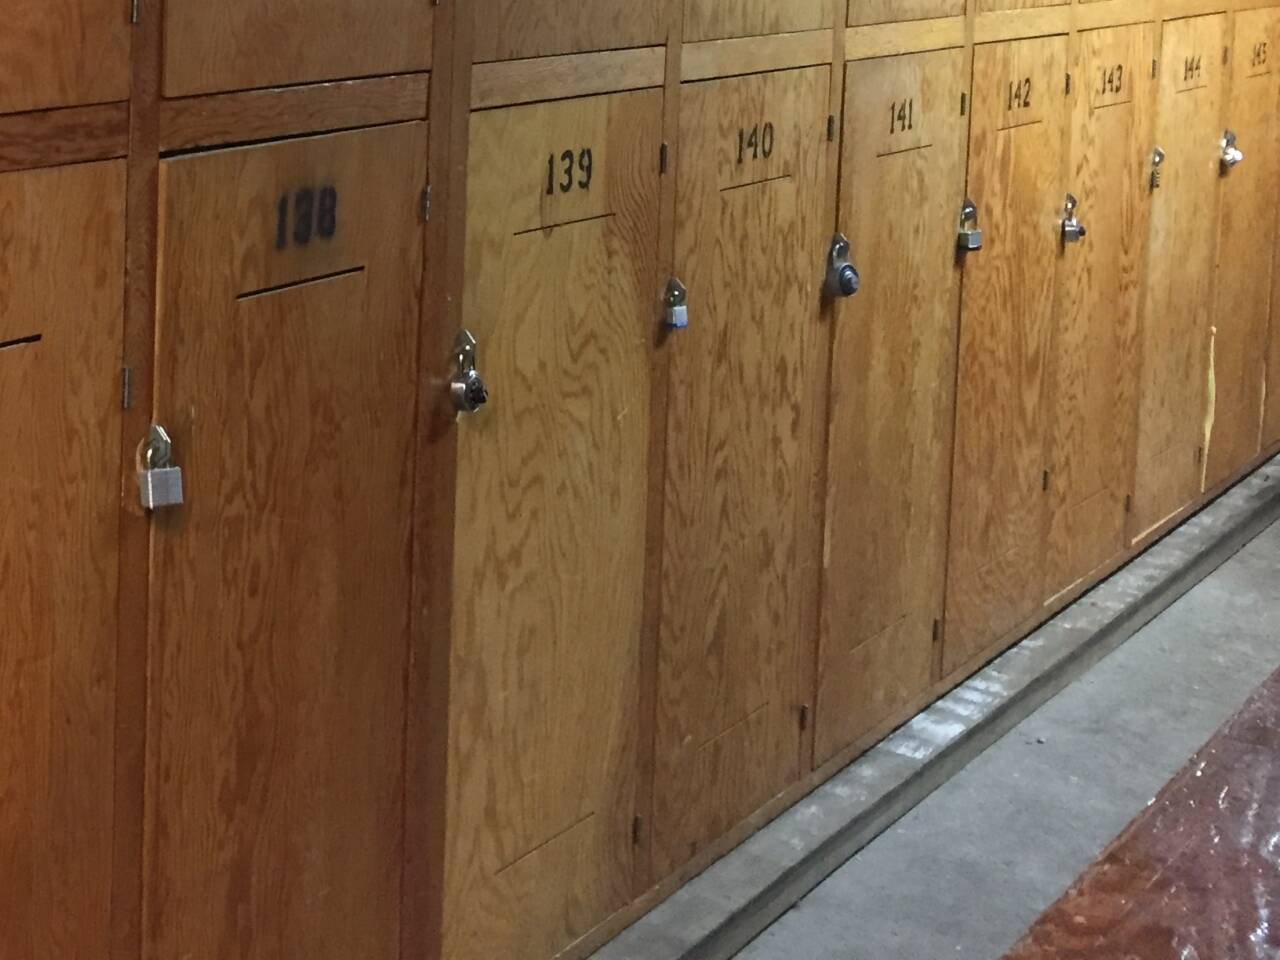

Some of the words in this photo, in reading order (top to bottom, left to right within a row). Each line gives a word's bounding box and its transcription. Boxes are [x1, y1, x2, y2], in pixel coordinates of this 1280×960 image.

[1102, 64, 1123, 96] 143
[1184, 55, 1201, 81] 144
[1007, 77, 1031, 111] 142
[889, 98, 913, 134] 141
[736, 121, 774, 165] 140
[545, 147, 593, 195] 139
